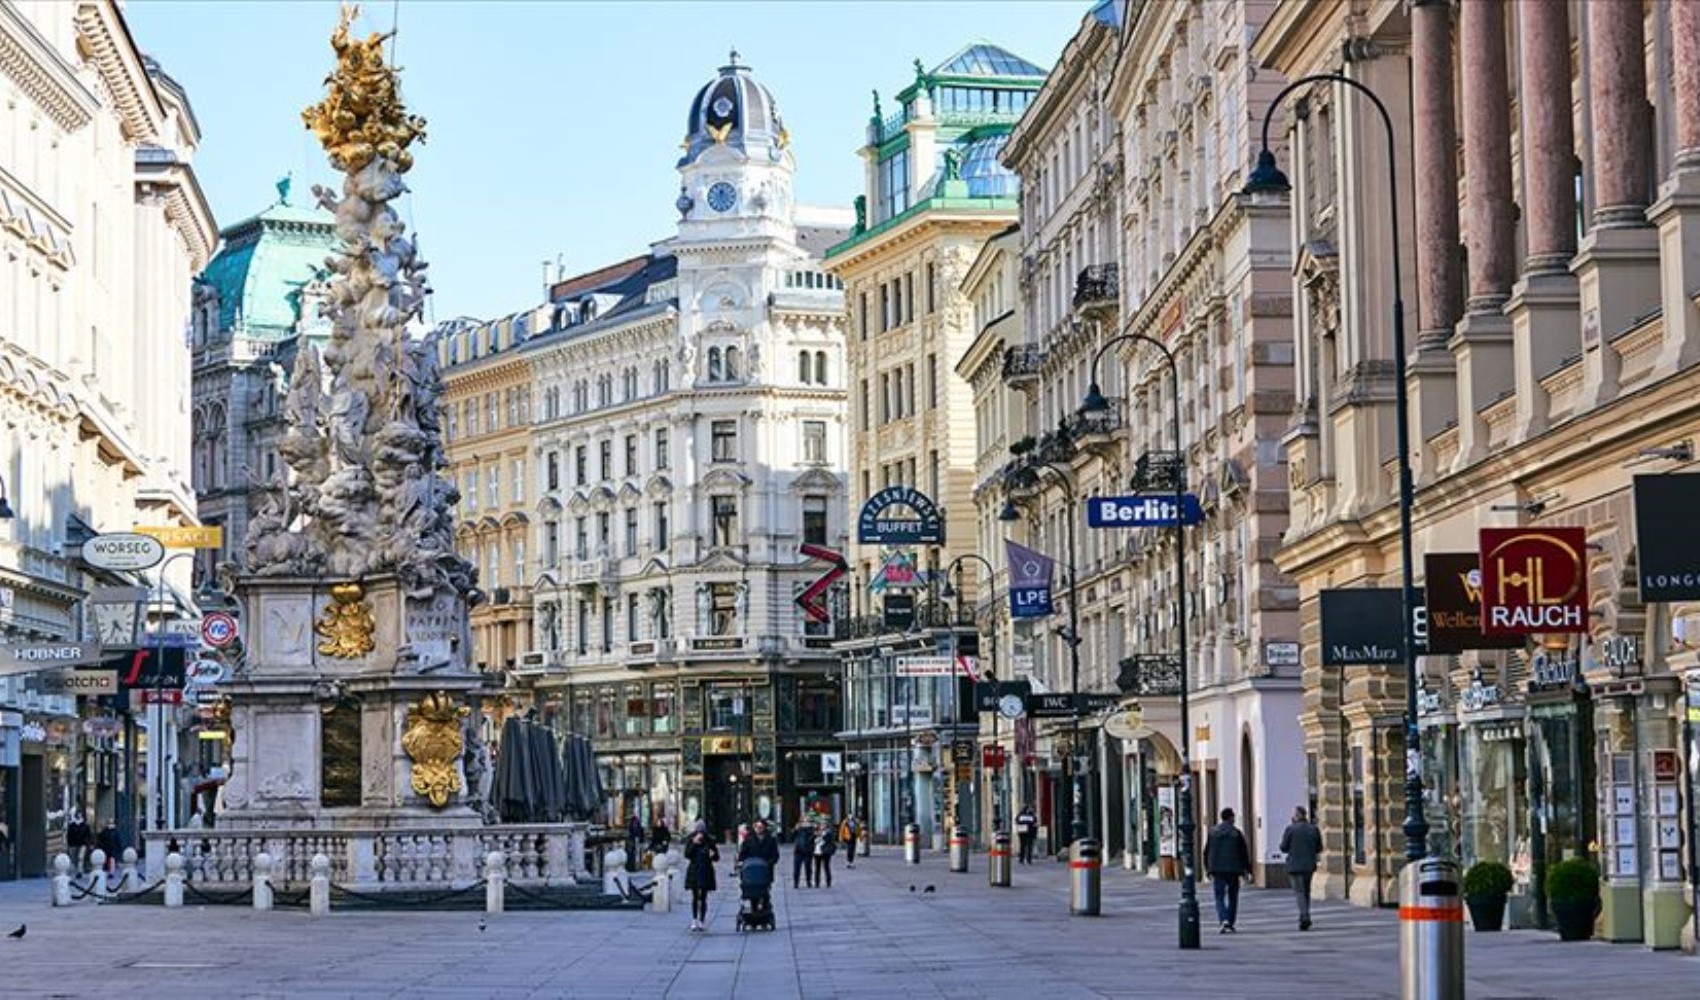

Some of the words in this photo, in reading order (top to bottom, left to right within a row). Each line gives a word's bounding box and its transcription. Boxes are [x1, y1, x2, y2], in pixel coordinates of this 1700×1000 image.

[1101, 499, 1186, 520] Berlitz
[877, 521, 923, 533] BUFFET
[94, 542, 152, 554] WORSEG
[1646, 574, 1700, 588] LONG
[1017, 590, 1049, 605] LPE
[1491, 605, 1581, 627] RAUCH
[1333, 645, 1398, 660] MaxMara
[1043, 697, 1068, 708] IWC
